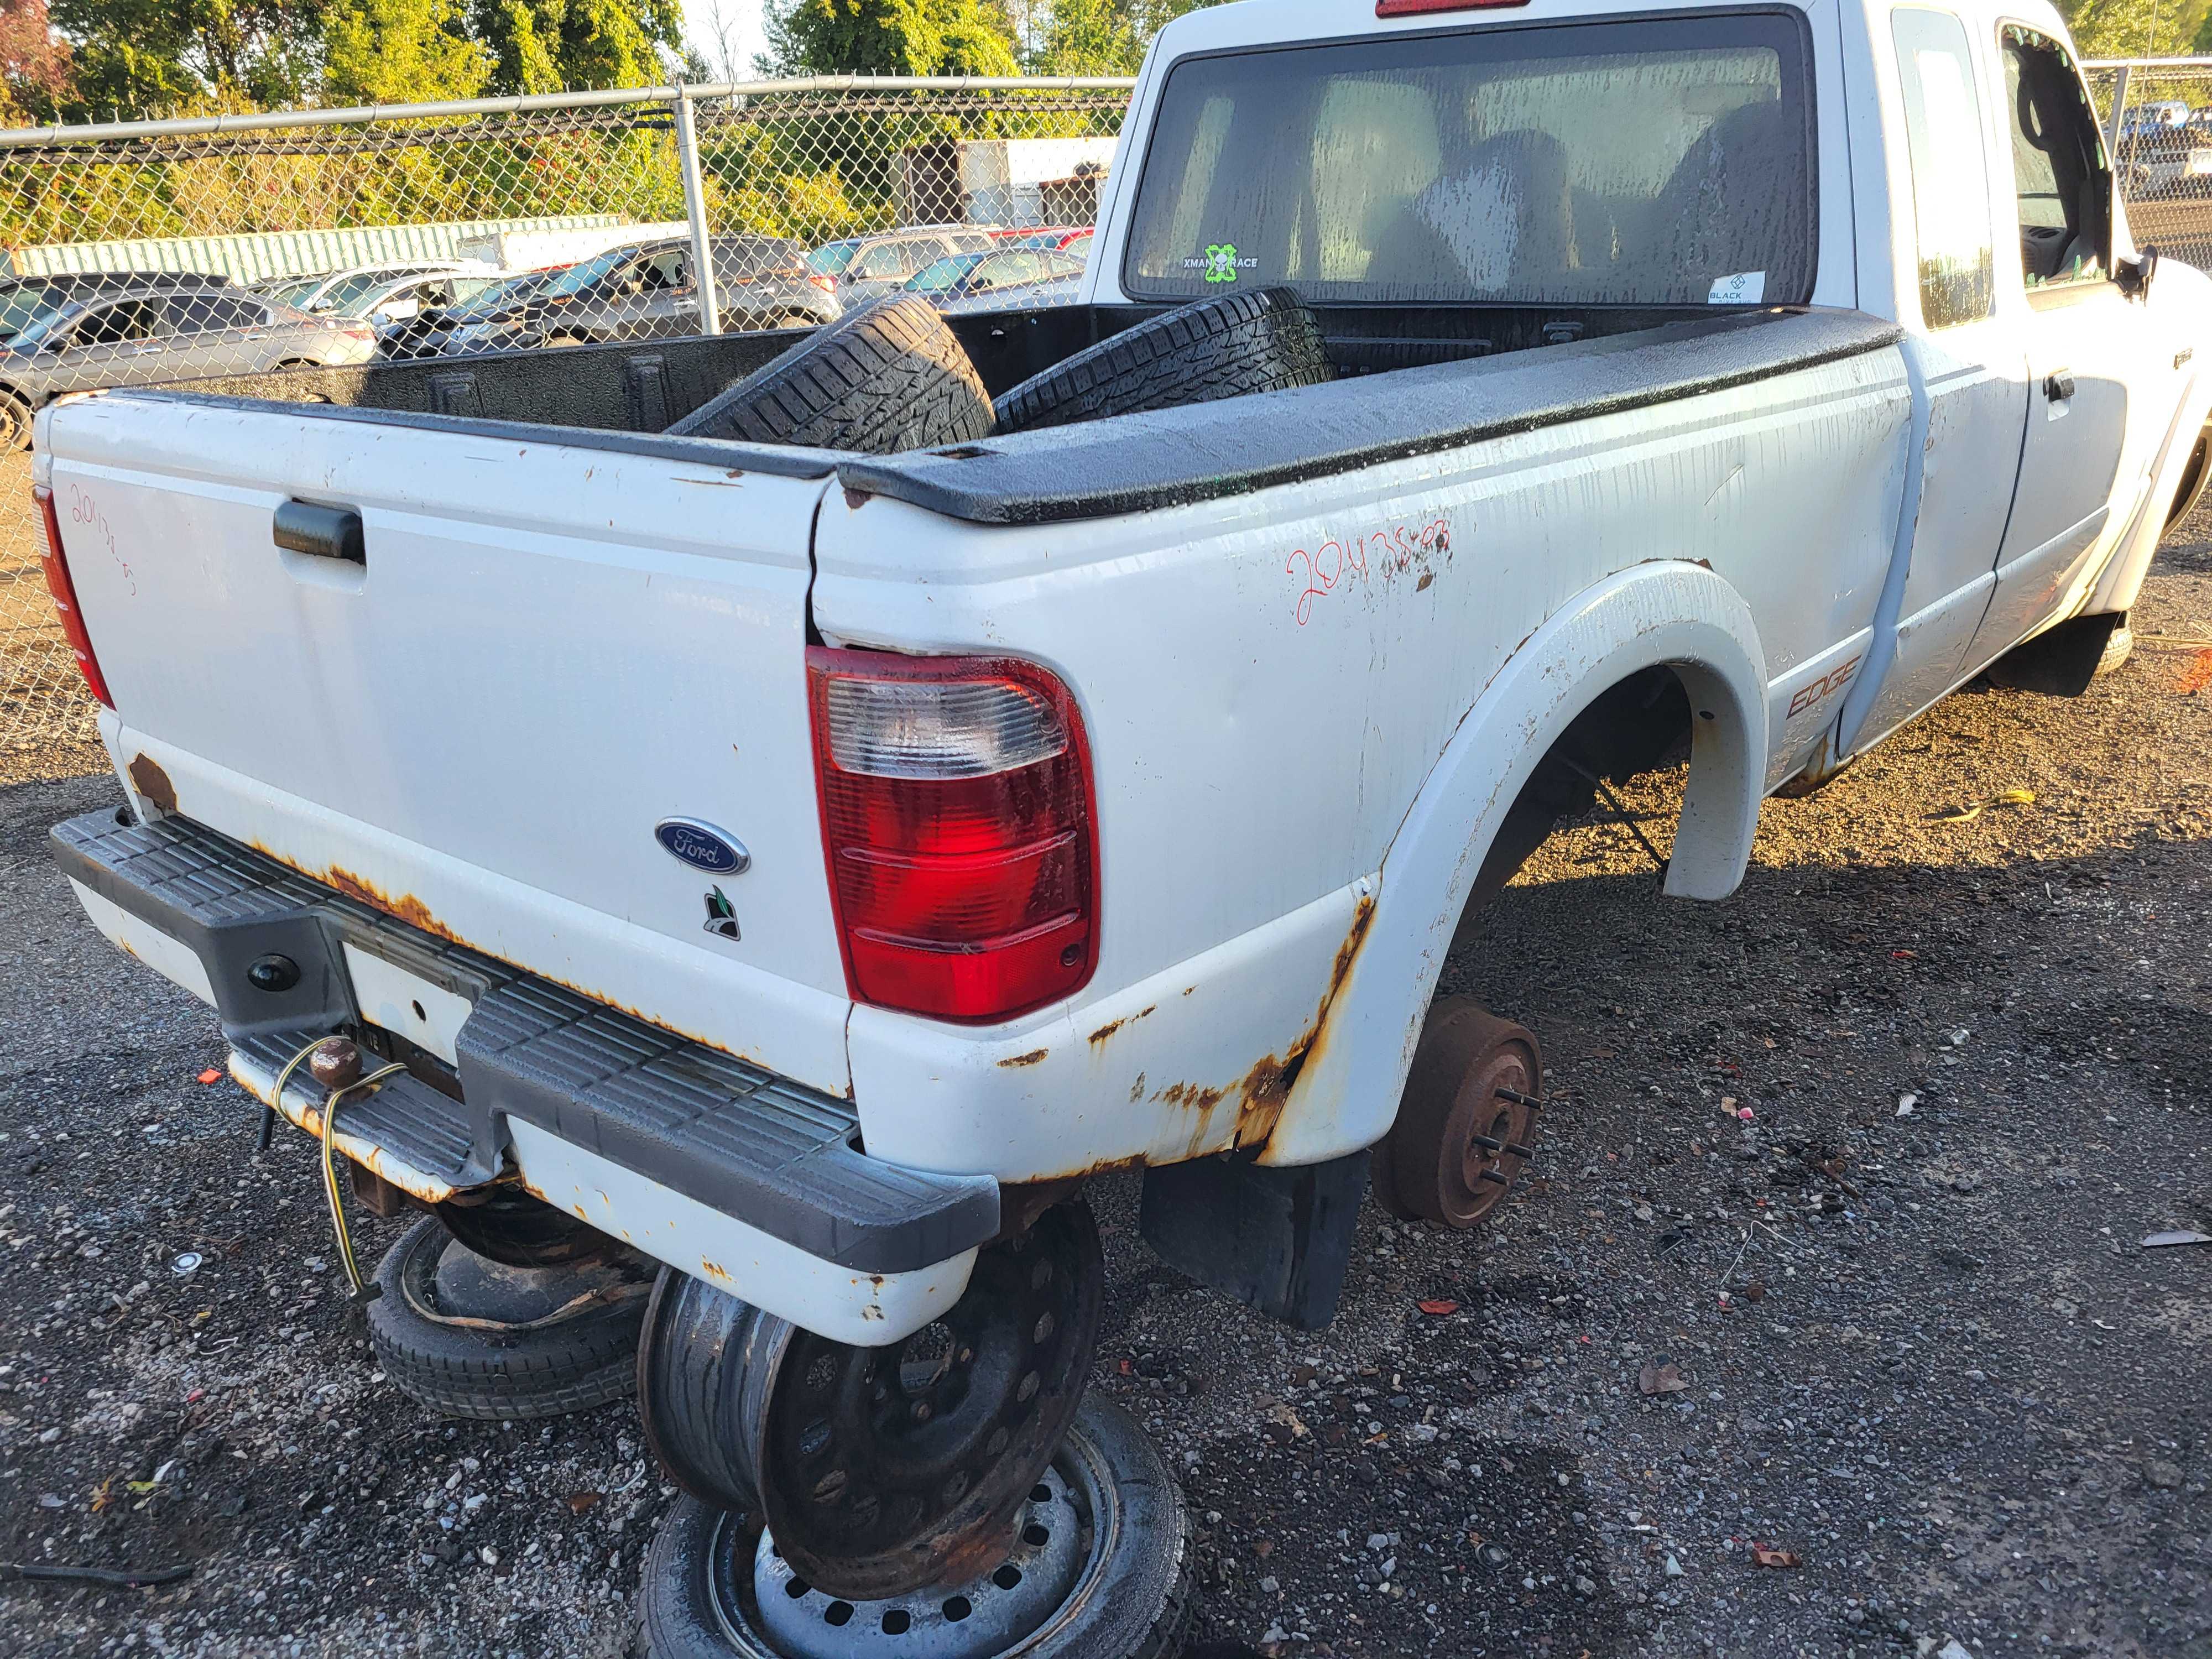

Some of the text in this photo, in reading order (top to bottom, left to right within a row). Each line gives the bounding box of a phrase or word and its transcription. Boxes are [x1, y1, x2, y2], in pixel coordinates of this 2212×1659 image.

[1183, 258, 1258, 268] XMAN RACE
[1786, 654, 1862, 720] EDGE
[674, 829, 719, 864] Ford
